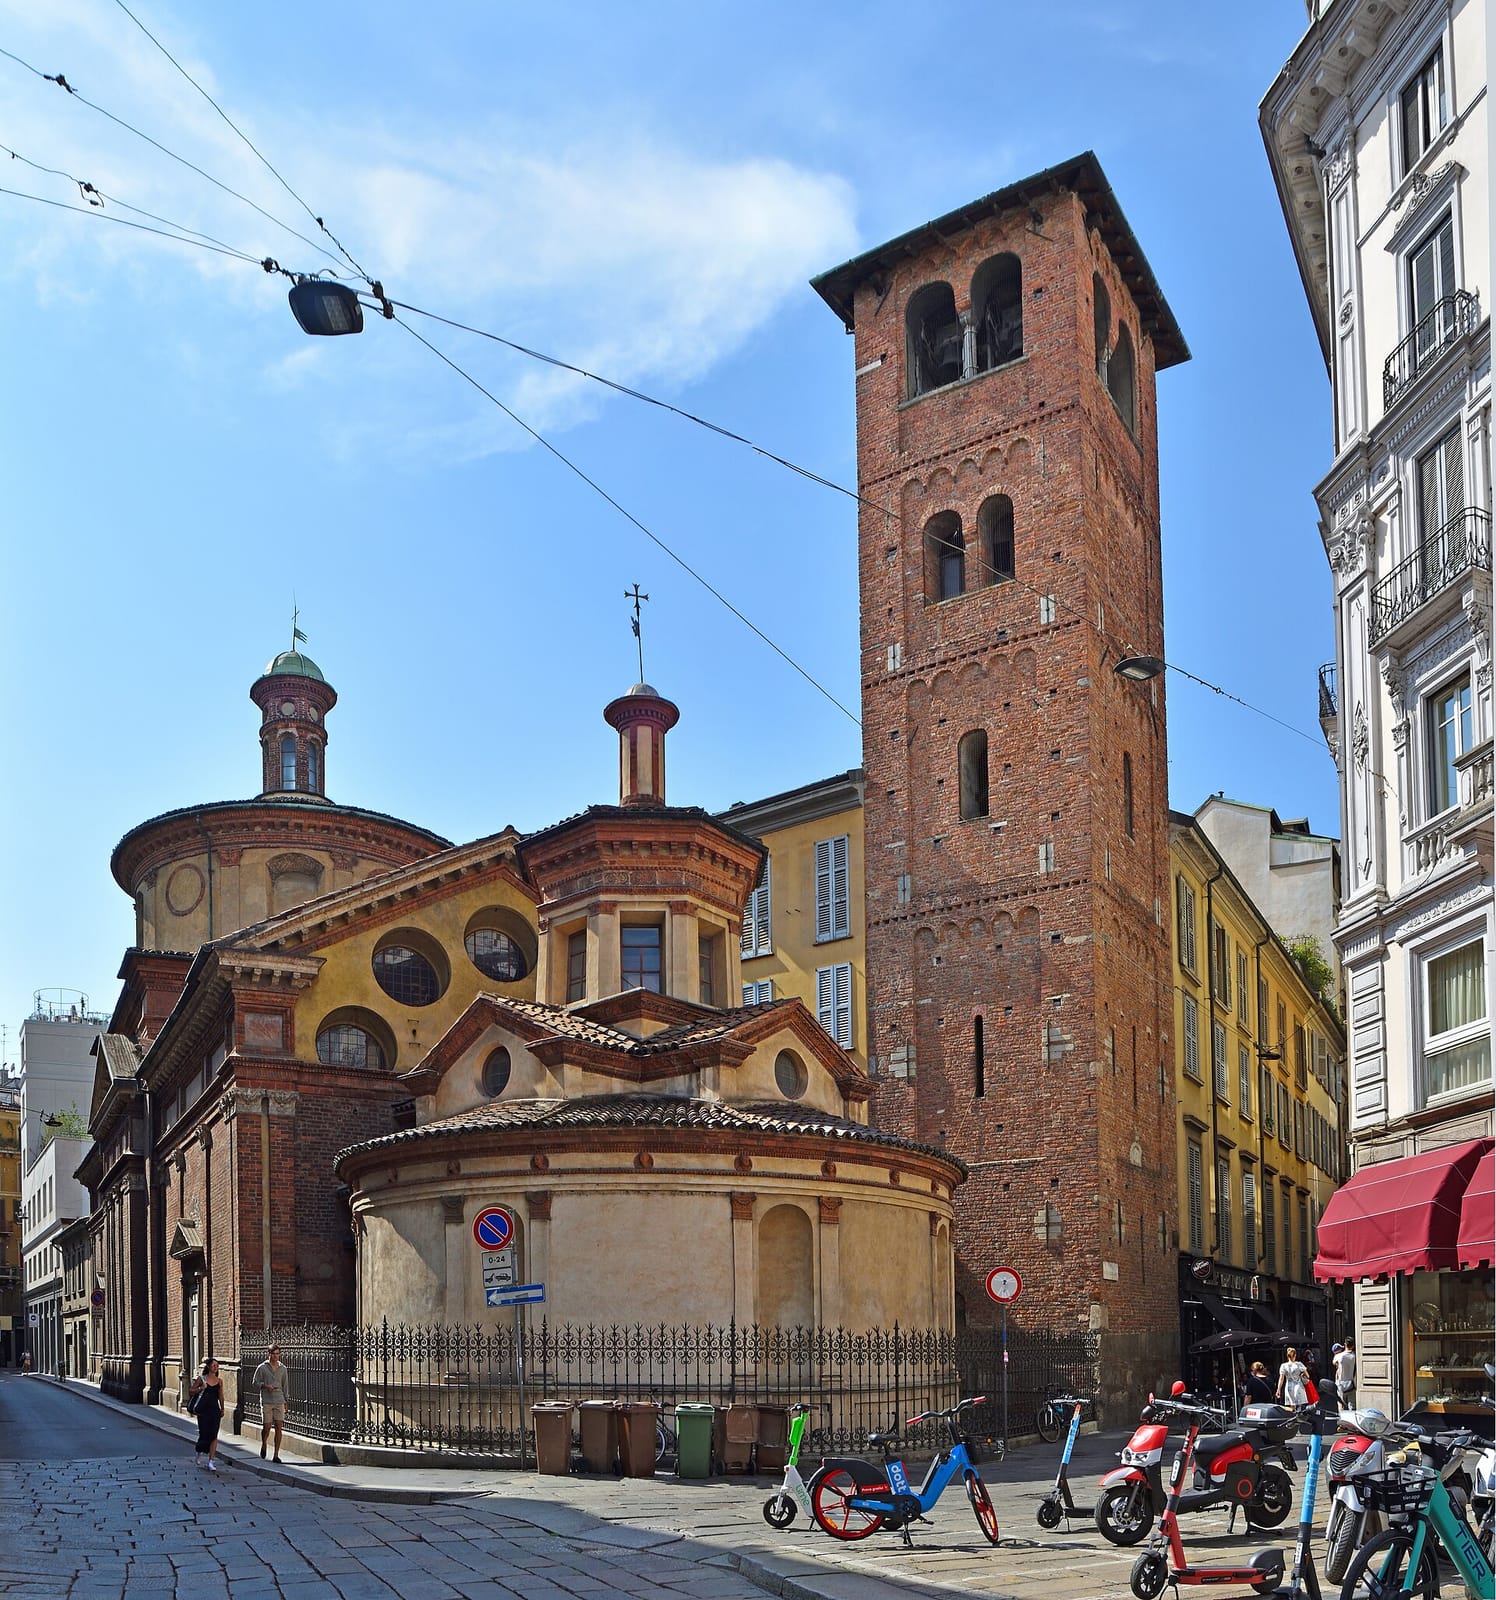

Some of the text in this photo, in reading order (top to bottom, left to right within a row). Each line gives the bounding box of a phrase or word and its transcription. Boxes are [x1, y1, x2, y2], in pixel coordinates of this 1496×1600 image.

[488, 1256, 505, 1264] 0-24
[890, 1465, 906, 1493] dott
[1305, 1458, 1319, 1506] HELBIZ
[1455, 1522, 1487, 1581] TIER
